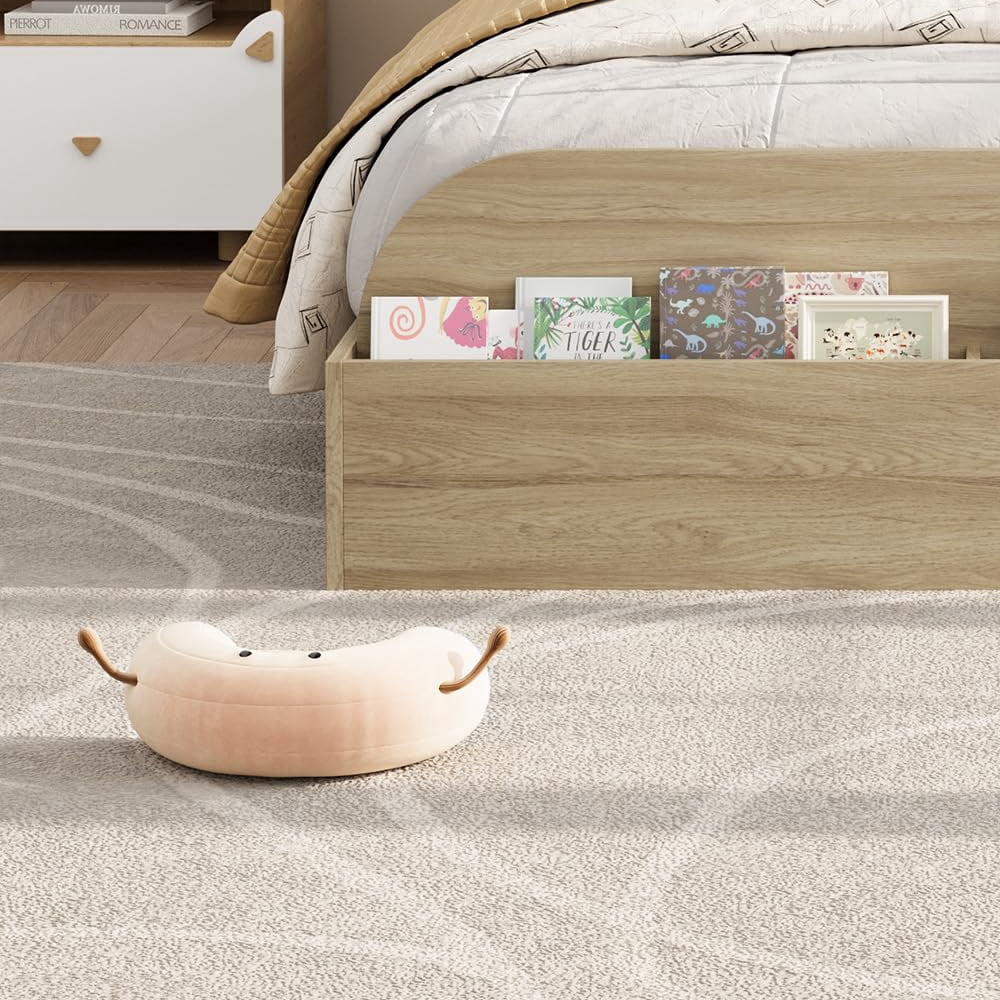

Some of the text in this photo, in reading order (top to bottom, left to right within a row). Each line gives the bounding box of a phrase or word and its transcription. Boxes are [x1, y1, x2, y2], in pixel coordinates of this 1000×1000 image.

[9, 17, 182, 31] PIERROT ROMANCE
[564, 330, 617, 353] TIGER
